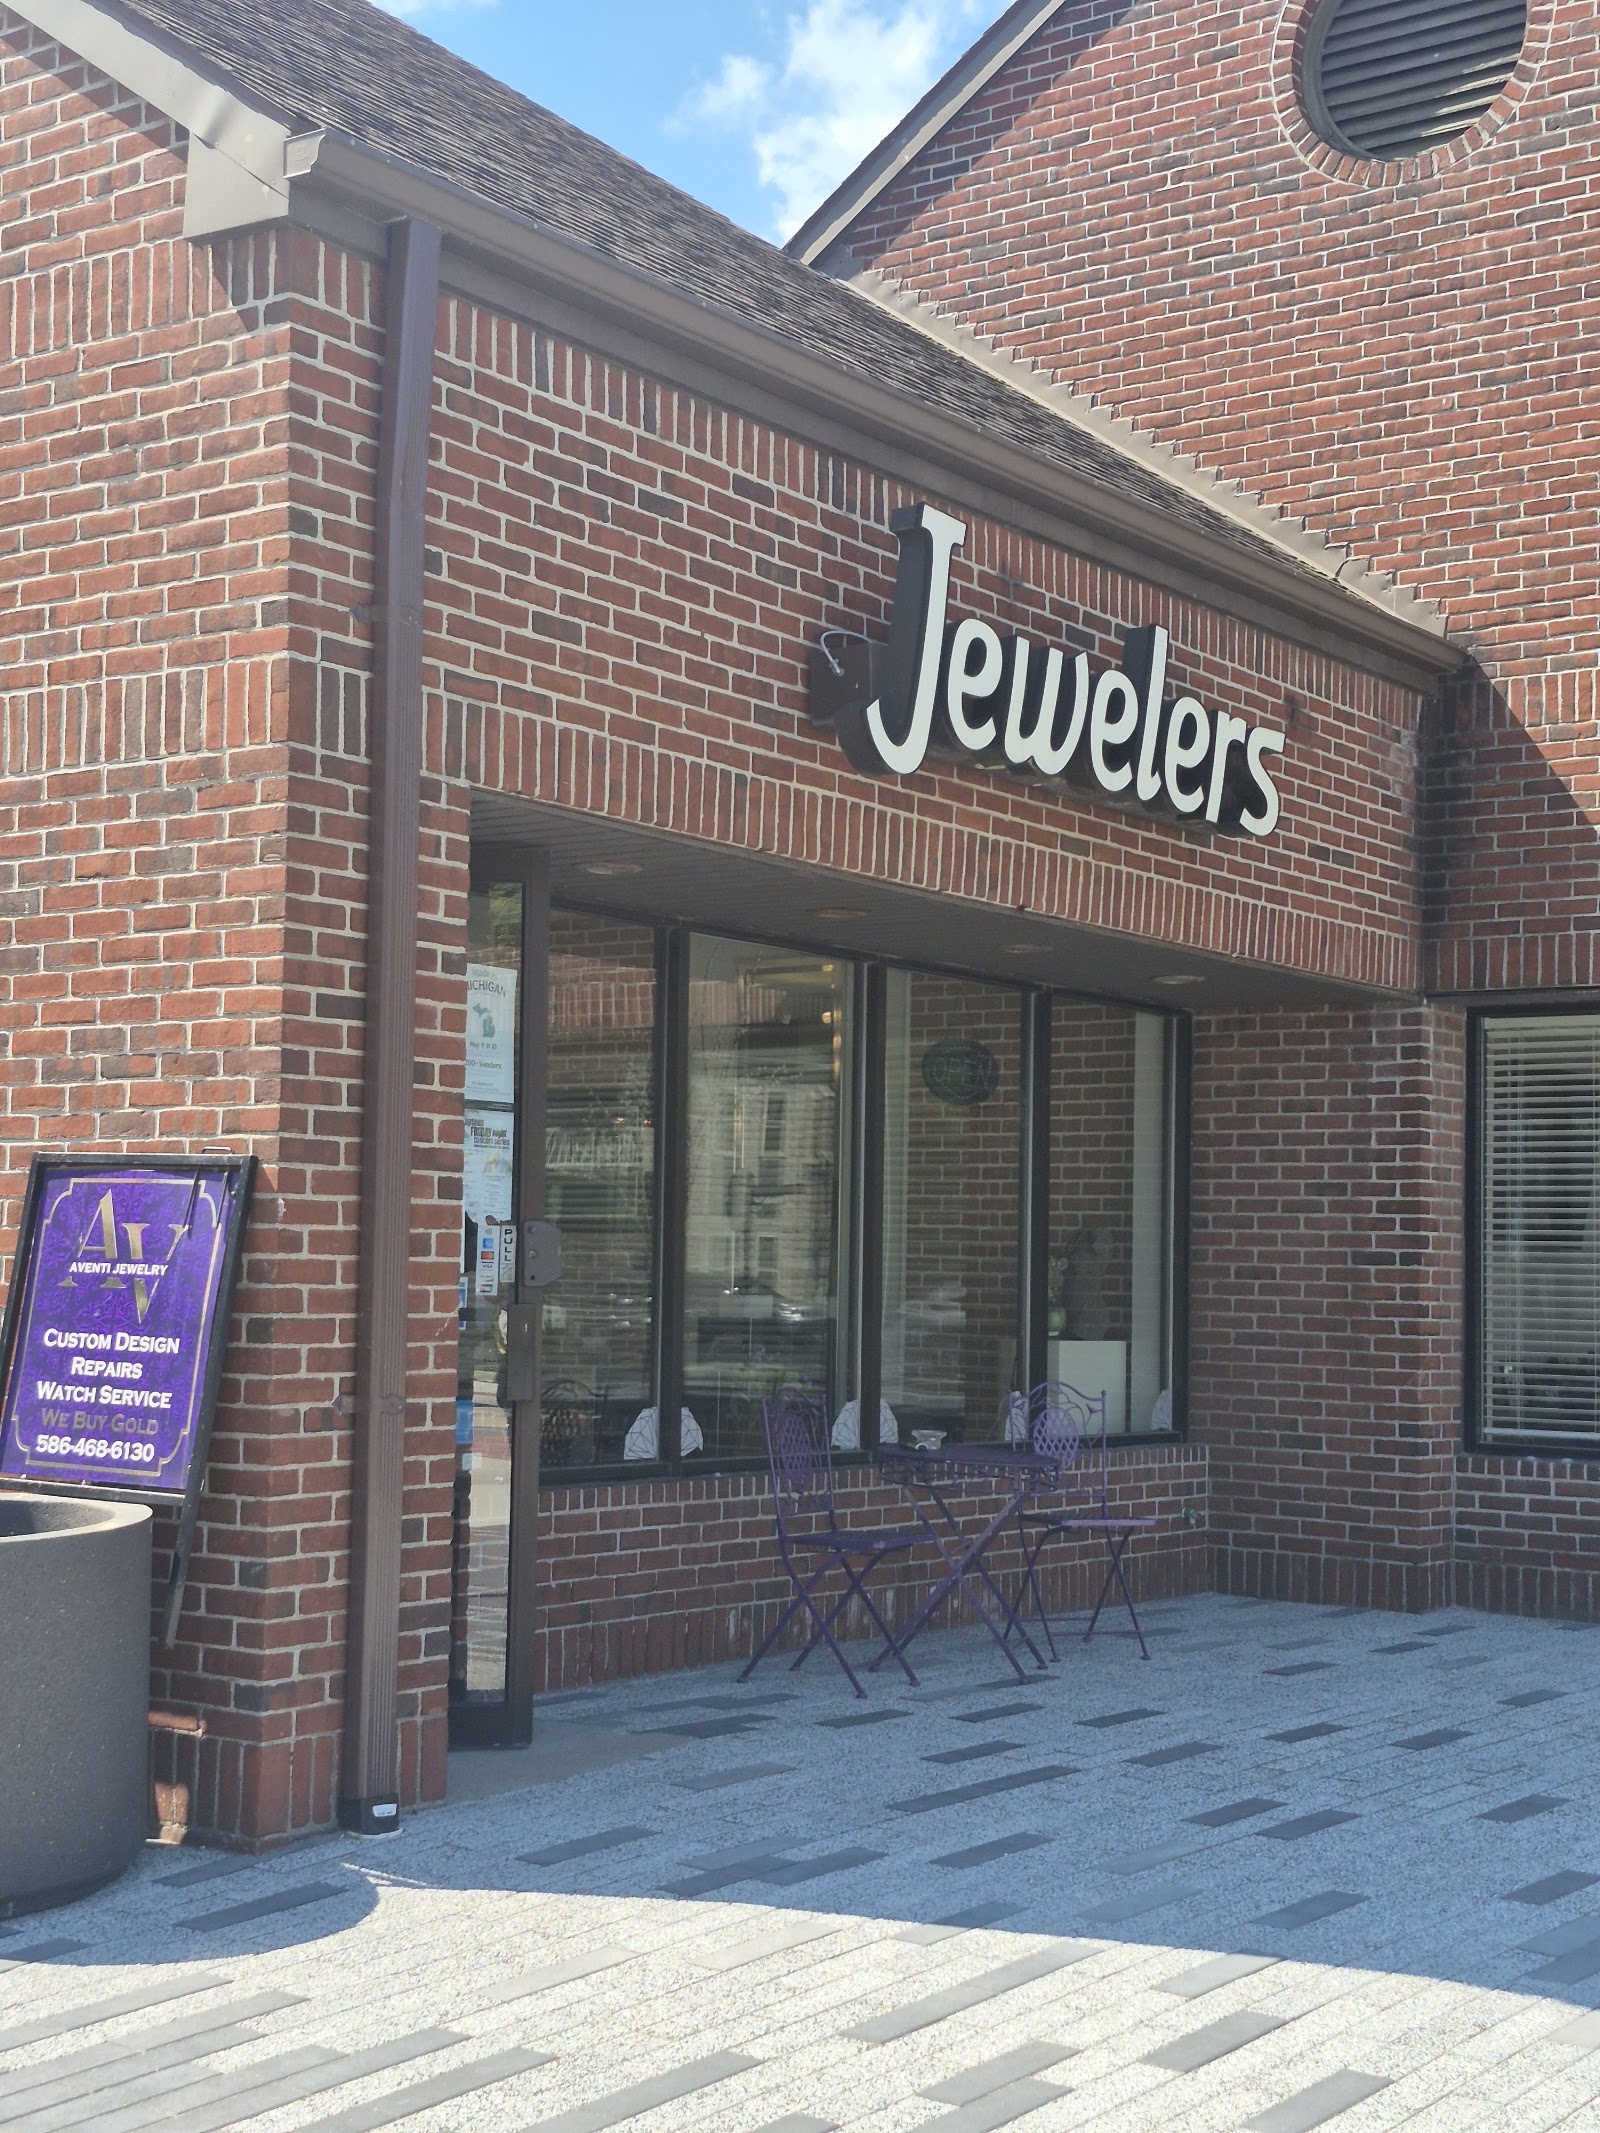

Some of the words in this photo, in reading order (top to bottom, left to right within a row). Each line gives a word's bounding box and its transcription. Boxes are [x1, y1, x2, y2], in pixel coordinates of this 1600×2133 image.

[866, 501, 1286, 837] Jewelers
[466, 979, 507, 997] ICHIGAN
[478, 1060, 502, 1070] Vendors
[471, 1126, 492, 1137] FRIDAY
[504, 1228, 513, 1262] PULL
[69, 1261, 111, 1275] AVENTI
[112, 1262, 169, 1277] JEWELRY
[43, 1328, 113, 1351] CUSTOM
[114, 1332, 181, 1354] DESIGN
[71, 1356, 144, 1380] REPAIRS
[36, 1381, 96, 1403] WATCH
[98, 1386, 173, 1409] SERVICE
[41, 1407, 71, 1429] WE
[72, 1410, 107, 1431] BUY
[111, 1413, 160, 1436] GOLD
[35, 1434, 156, 1463] 586-468-6130
